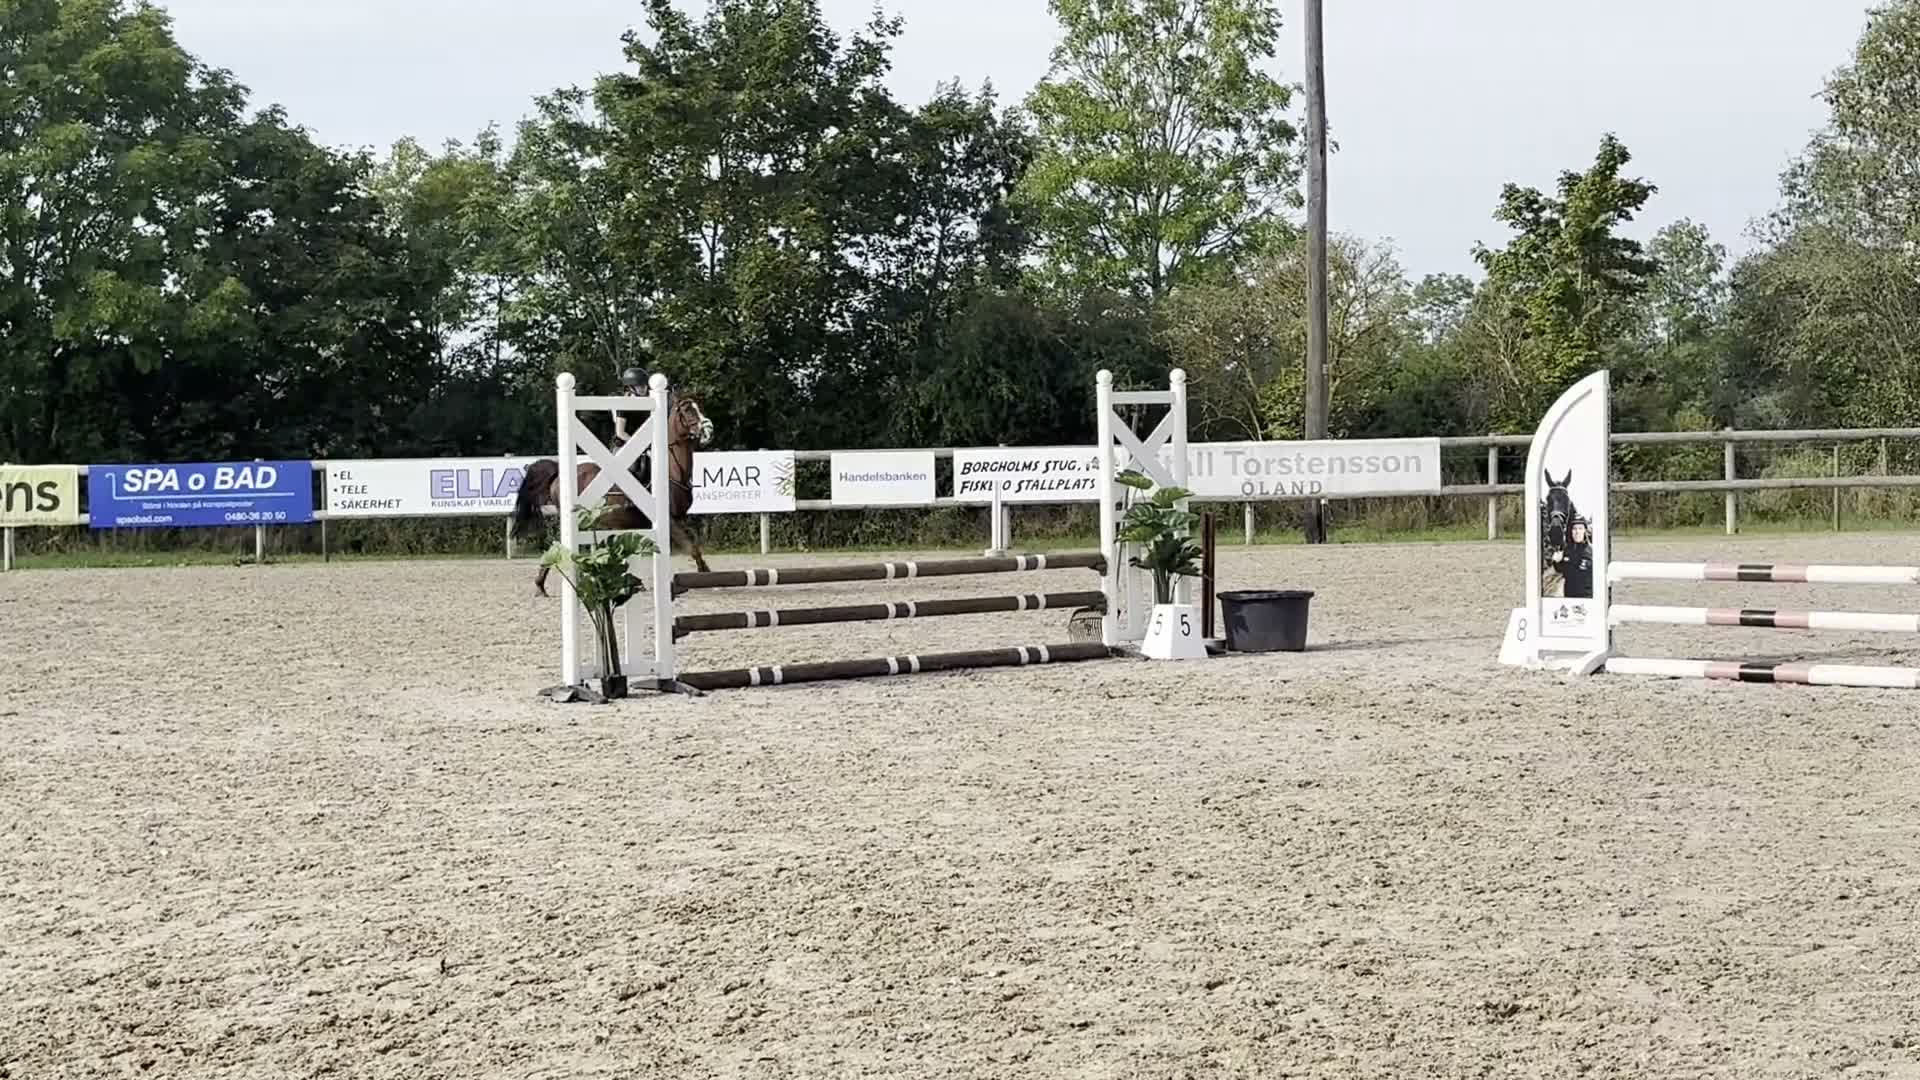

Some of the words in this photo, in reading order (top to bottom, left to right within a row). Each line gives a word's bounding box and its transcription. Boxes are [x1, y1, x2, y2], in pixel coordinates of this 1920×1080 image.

[960, 461, 1040, 475] BORGHOLMS
[1224, 450, 1421, 477] Torstensson
[123, 468, 180, 492] SPA
[188, 473, 206, 491] o
[213, 466, 277, 490] BAD
[340, 470, 353, 480] EL
[839, 471, 928, 482] Handelsbanken
[340, 485, 368, 495] TELE
[1014, 478, 1096, 493] STALLPLATS
[0, 480, 60, 512] ns
[431, 500, 477, 508] KUNSKAP
[262, 511, 273, 521] 20
[1180, 613, 1191, 637] 5
[1517, 618, 1527, 642] 8
